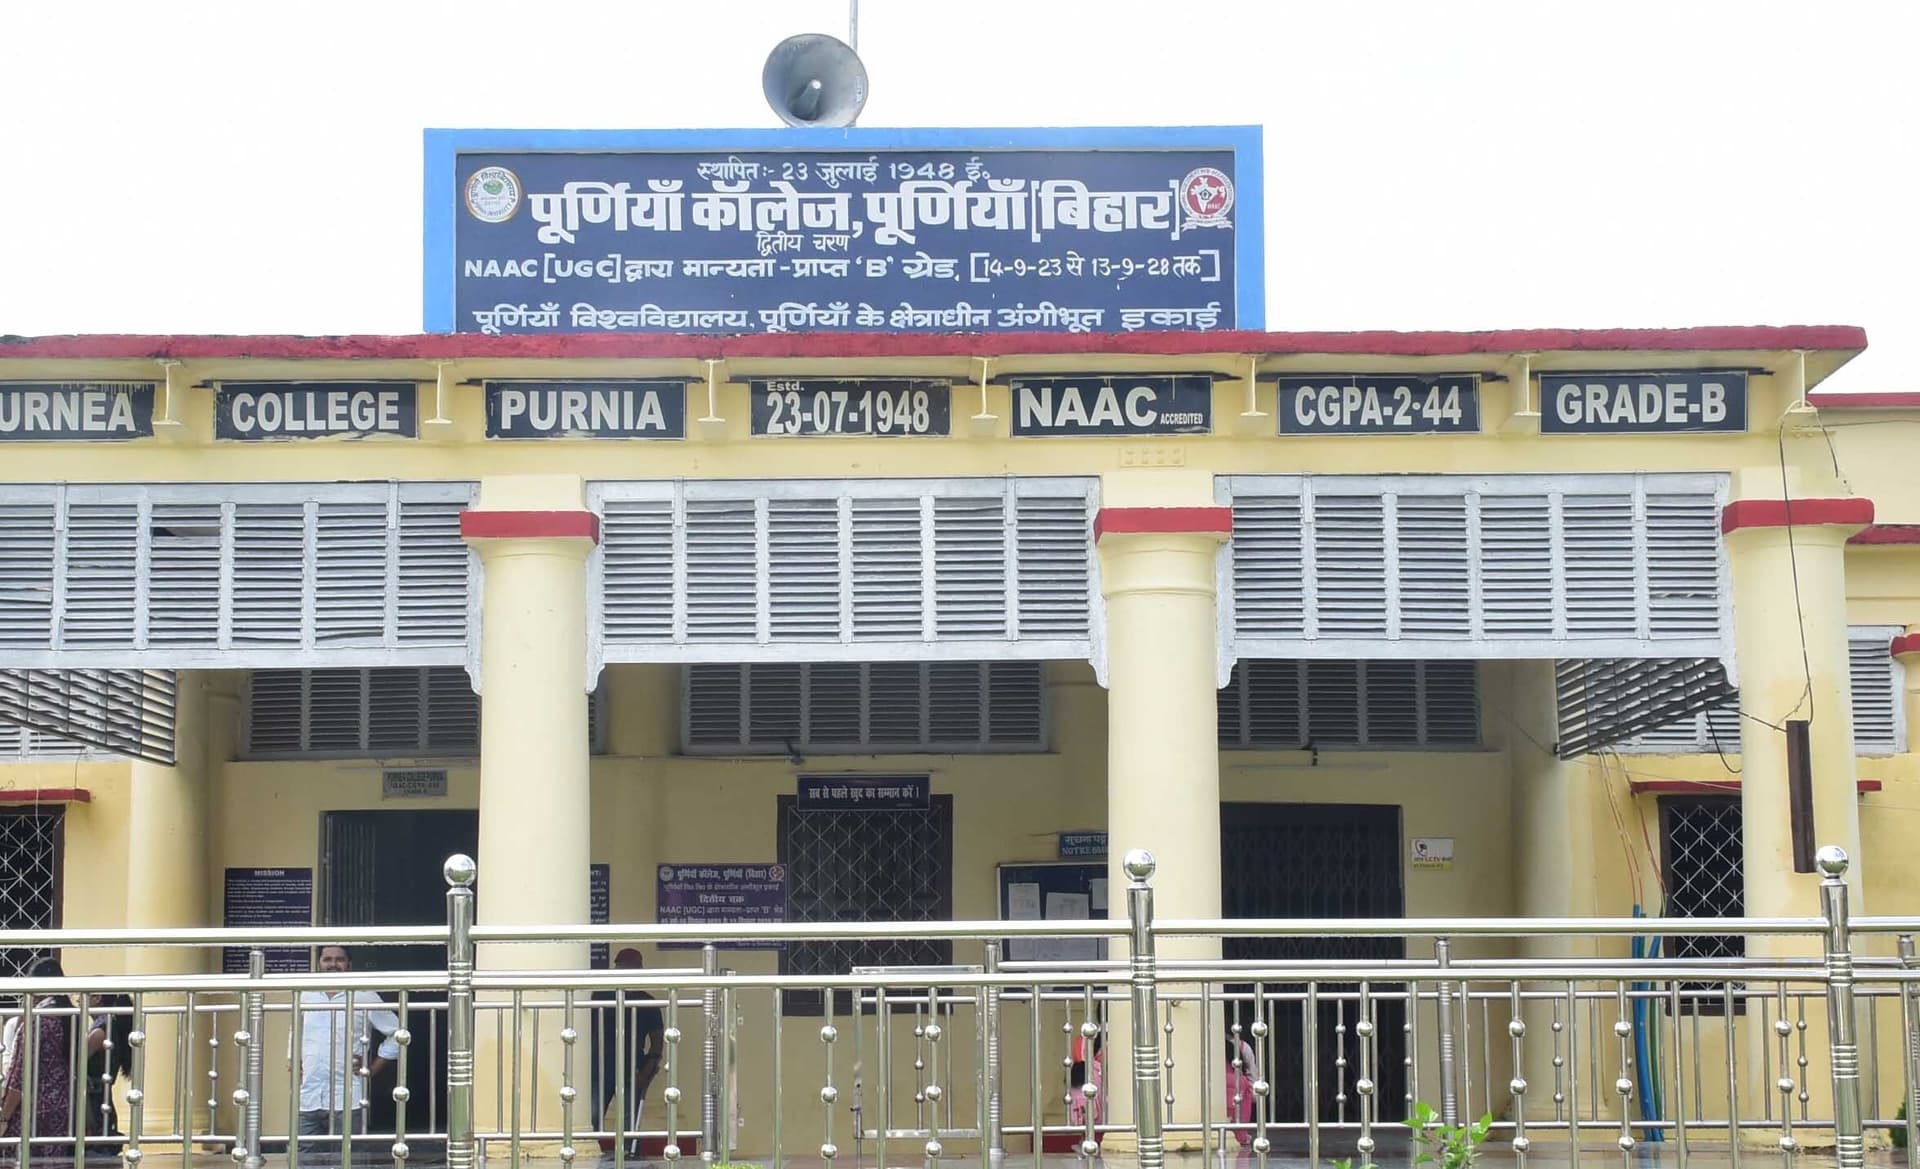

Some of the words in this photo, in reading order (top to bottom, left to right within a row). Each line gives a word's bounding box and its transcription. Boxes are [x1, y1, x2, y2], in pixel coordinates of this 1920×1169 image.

[782, 162, 808, 180] 23
[816, 156, 879, 188] जुलाई
[889, 161, 955, 180] 1948
[528, 179, 685, 244] पूर्णियाँ
[863, 179, 1029, 245] पूर्णियाँ
[812, 234, 850, 252] चरण
[464, 258, 539, 278] NAAC
[543, 253, 621, 283] [UGC]
[625, 259, 674, 282] द्वारा
[1066, 250, 1085, 277] से
[1092, 256, 1169, 277] 13-9-28
[472, 302, 560, 334] पूर्णियाँ
[758, 301, 850, 333] पूर्णियाँ
[856, 302, 885, 327] के
[890, 301, 992, 329] क्षेत्राधीन
[997, 302, 1105, 332] अंगीभूत
[231, 391, 399, 432] COLLEGE
[502, 390, 667, 431] PURNIA
[766, 390, 930, 434] 23-07-1948
[1019, 386, 1157, 427] NAAC
[1160, 413, 1203, 425] ACCREDITED
[1555, 382, 1728, 424] GRADE-B
